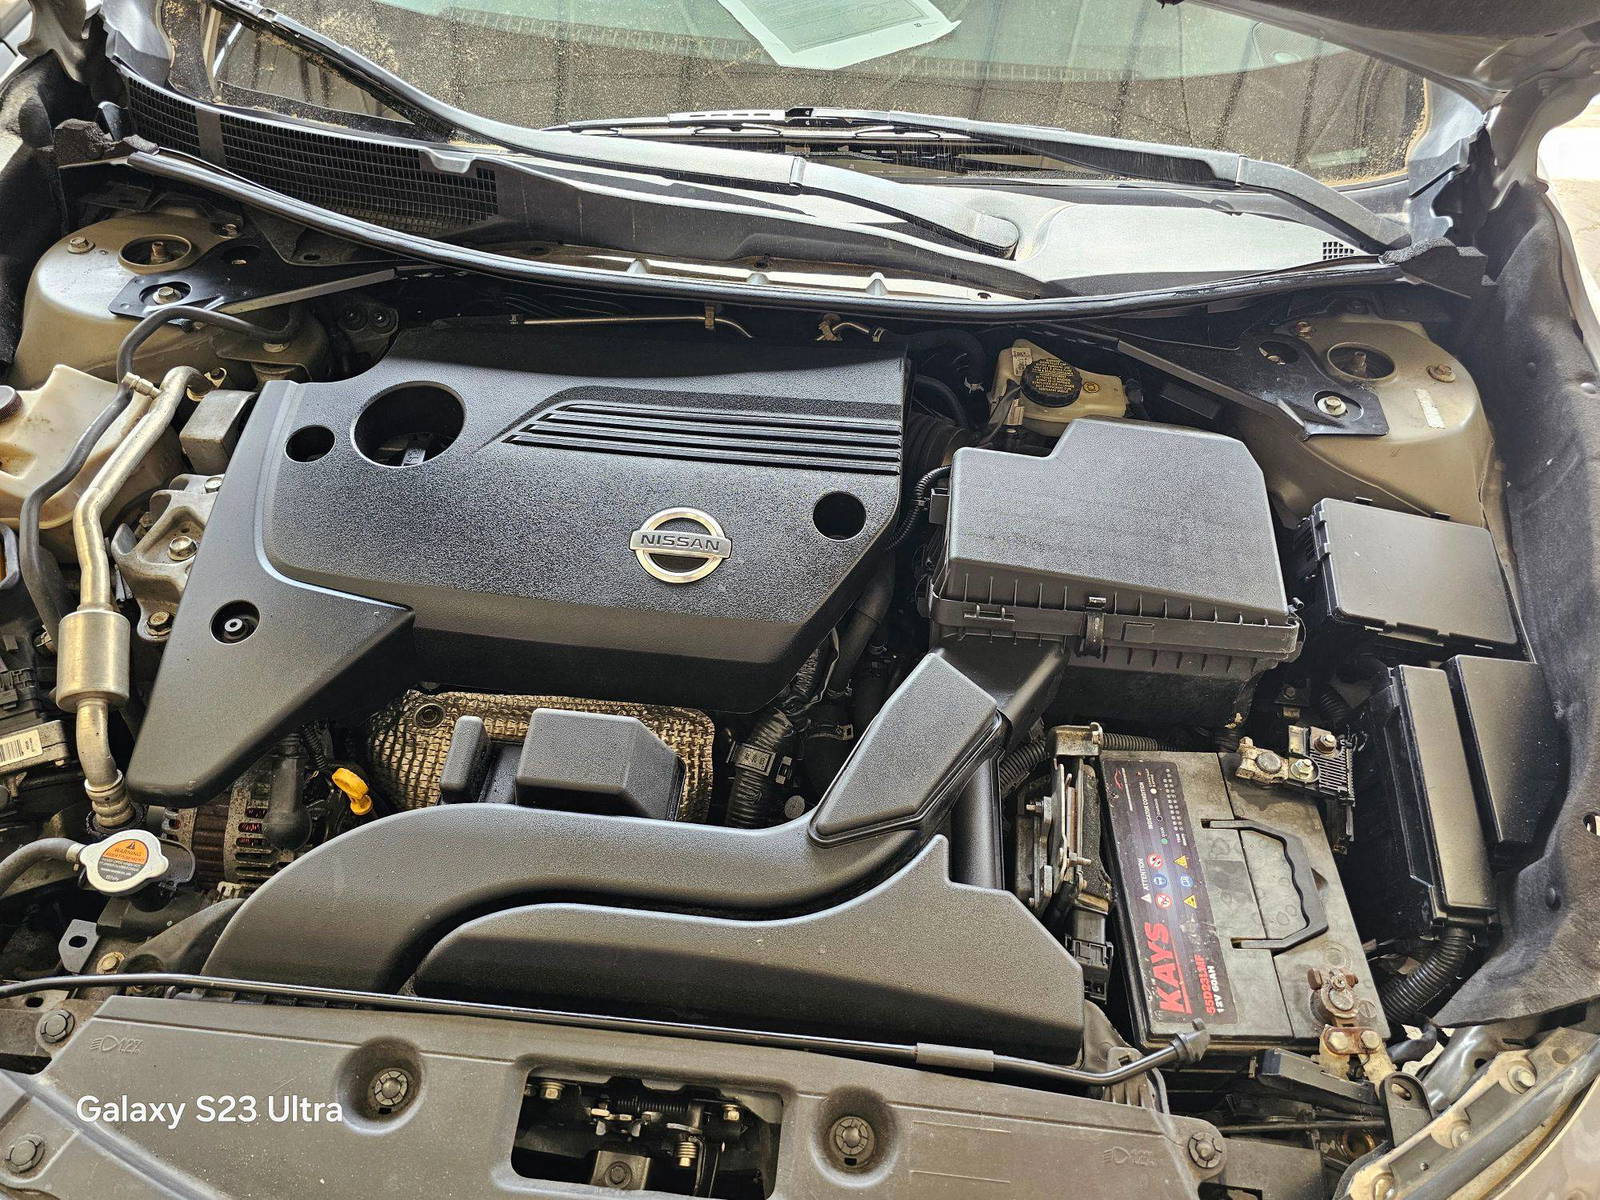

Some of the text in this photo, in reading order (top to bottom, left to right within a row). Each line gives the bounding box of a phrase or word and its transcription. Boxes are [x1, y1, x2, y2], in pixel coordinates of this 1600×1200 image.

[640, 534, 720, 551] NISSAN
[1137, 857, 1150, 890] ATTENTION
[1144, 922, 1185, 1013] KAYS
[1207, 965, 1225, 1013] 12V 60AH
